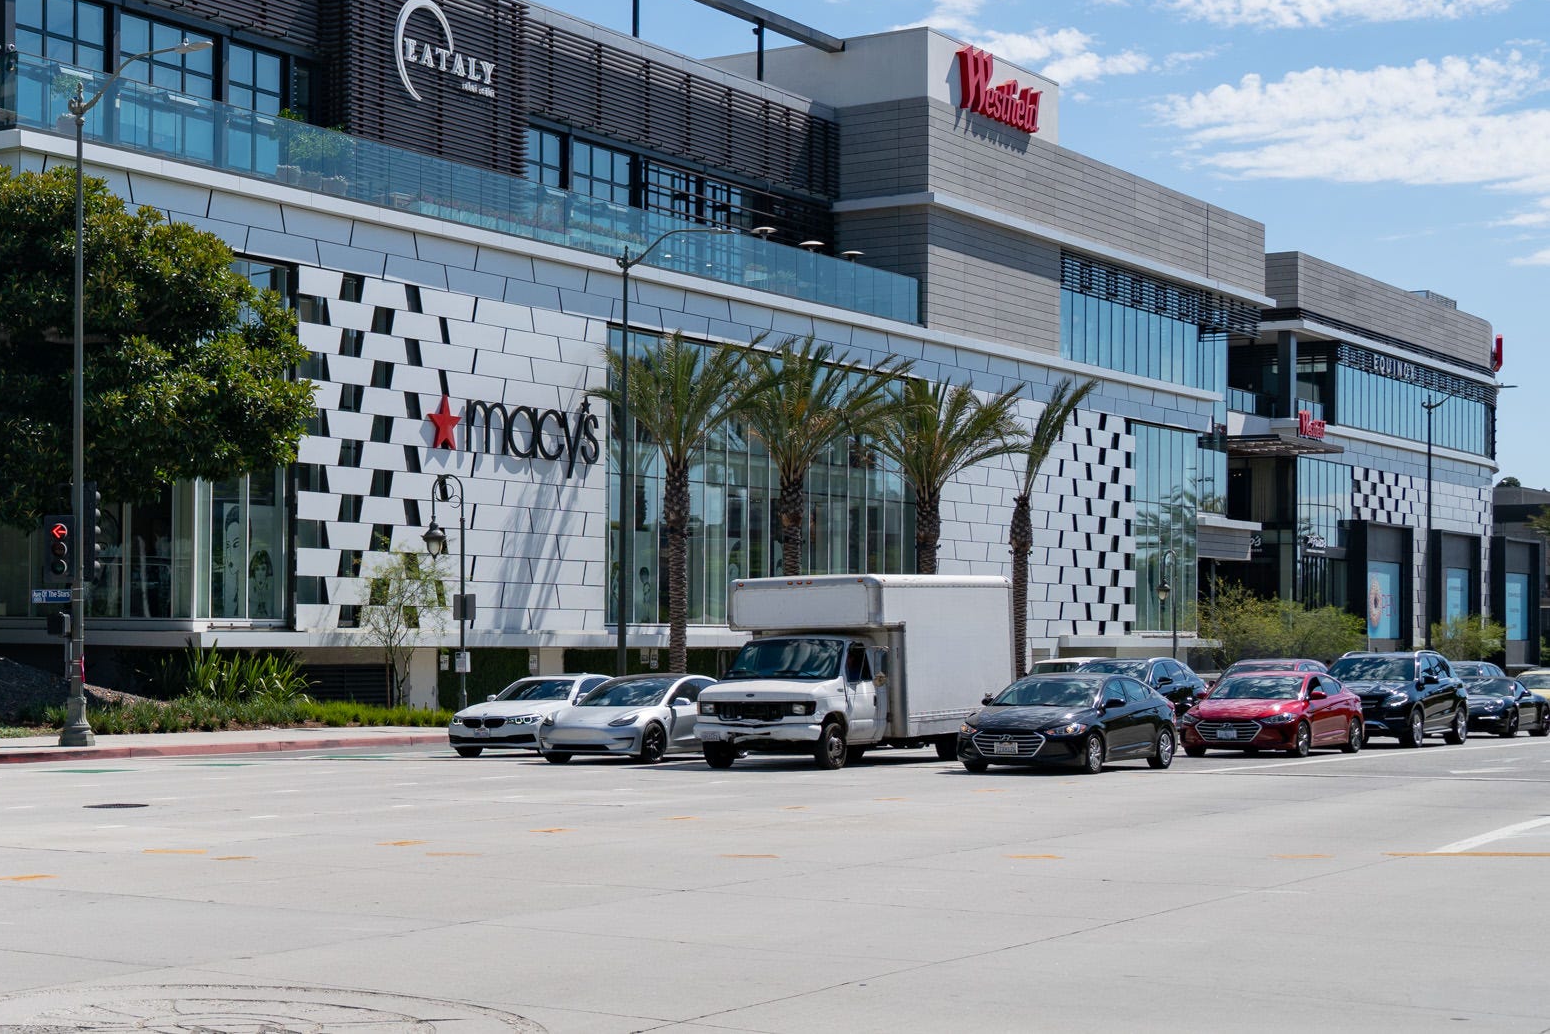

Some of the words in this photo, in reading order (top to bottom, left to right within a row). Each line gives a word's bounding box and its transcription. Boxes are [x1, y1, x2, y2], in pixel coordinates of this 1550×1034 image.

[403, 37, 496, 85] EATALY
[955, 45, 1043, 134] Westfield
[1373, 354, 1415, 381] EQUINOX
[466, 396, 600, 479] macy's
